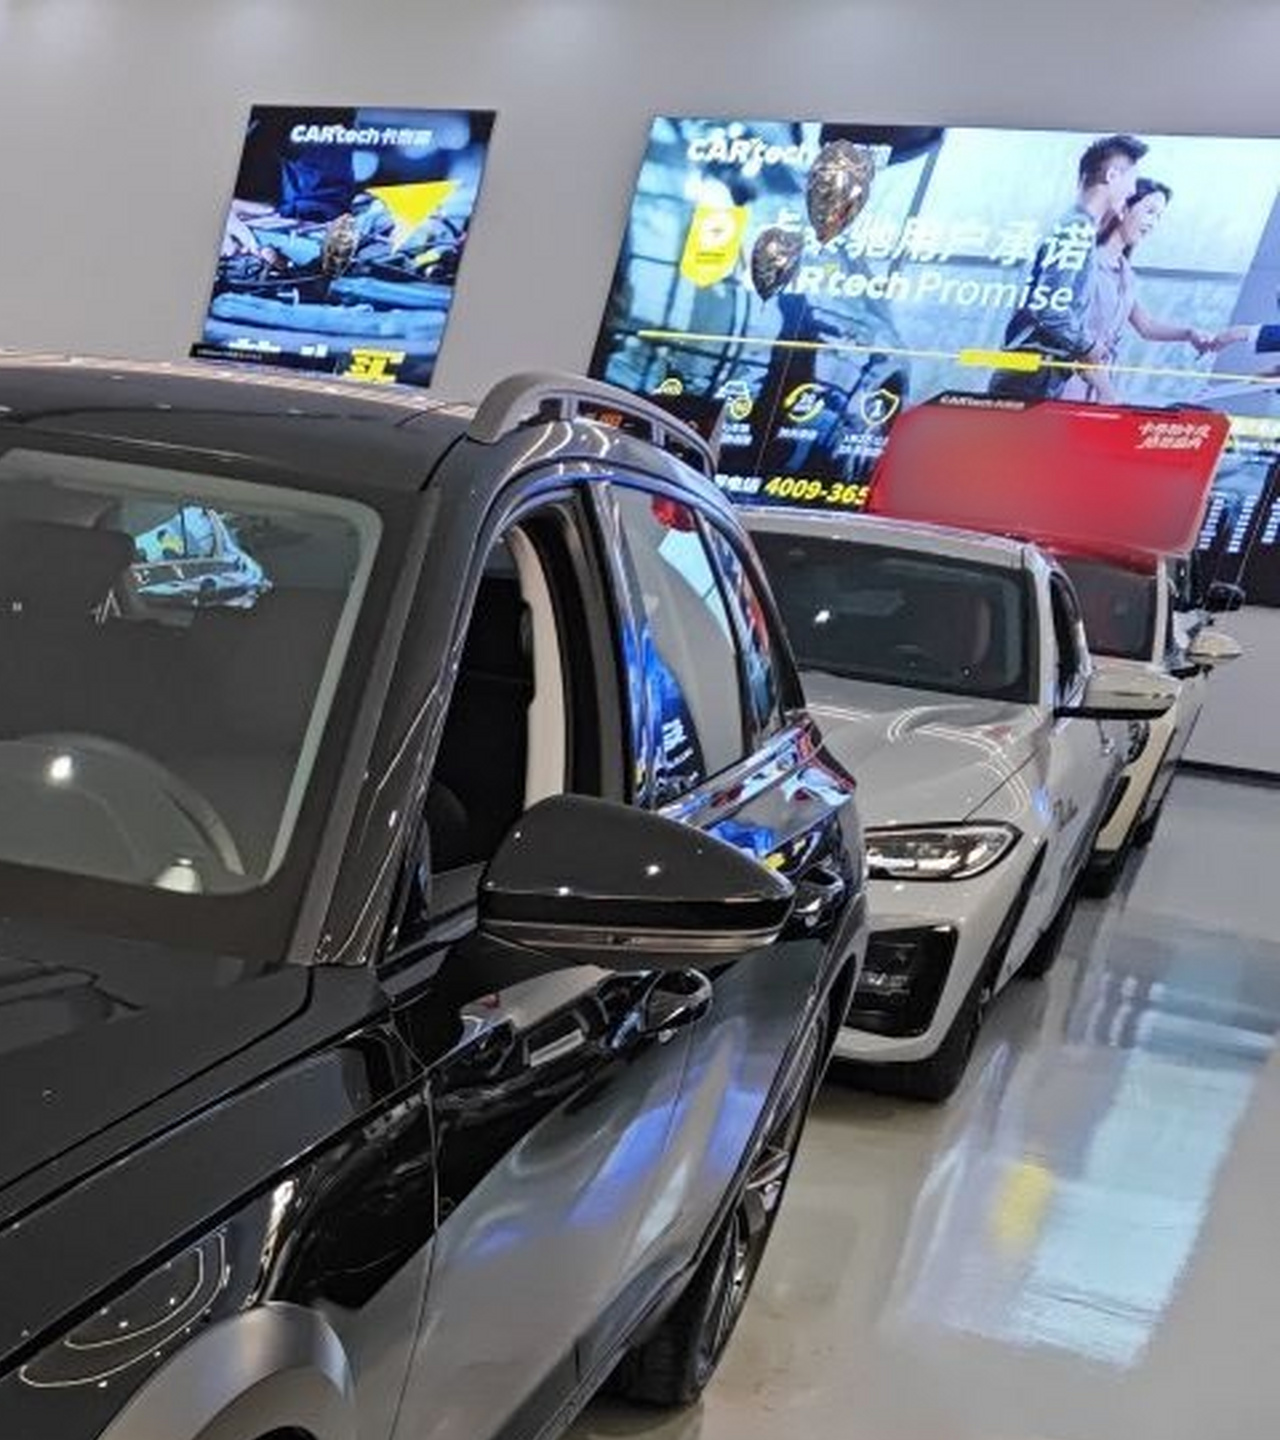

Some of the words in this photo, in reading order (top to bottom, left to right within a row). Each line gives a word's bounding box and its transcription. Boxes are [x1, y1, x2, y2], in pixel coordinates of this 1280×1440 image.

[291, 124, 380, 145] CARtech
[742, 262, 910, 301] Rtech
[915, 270, 1073, 311] Promise
